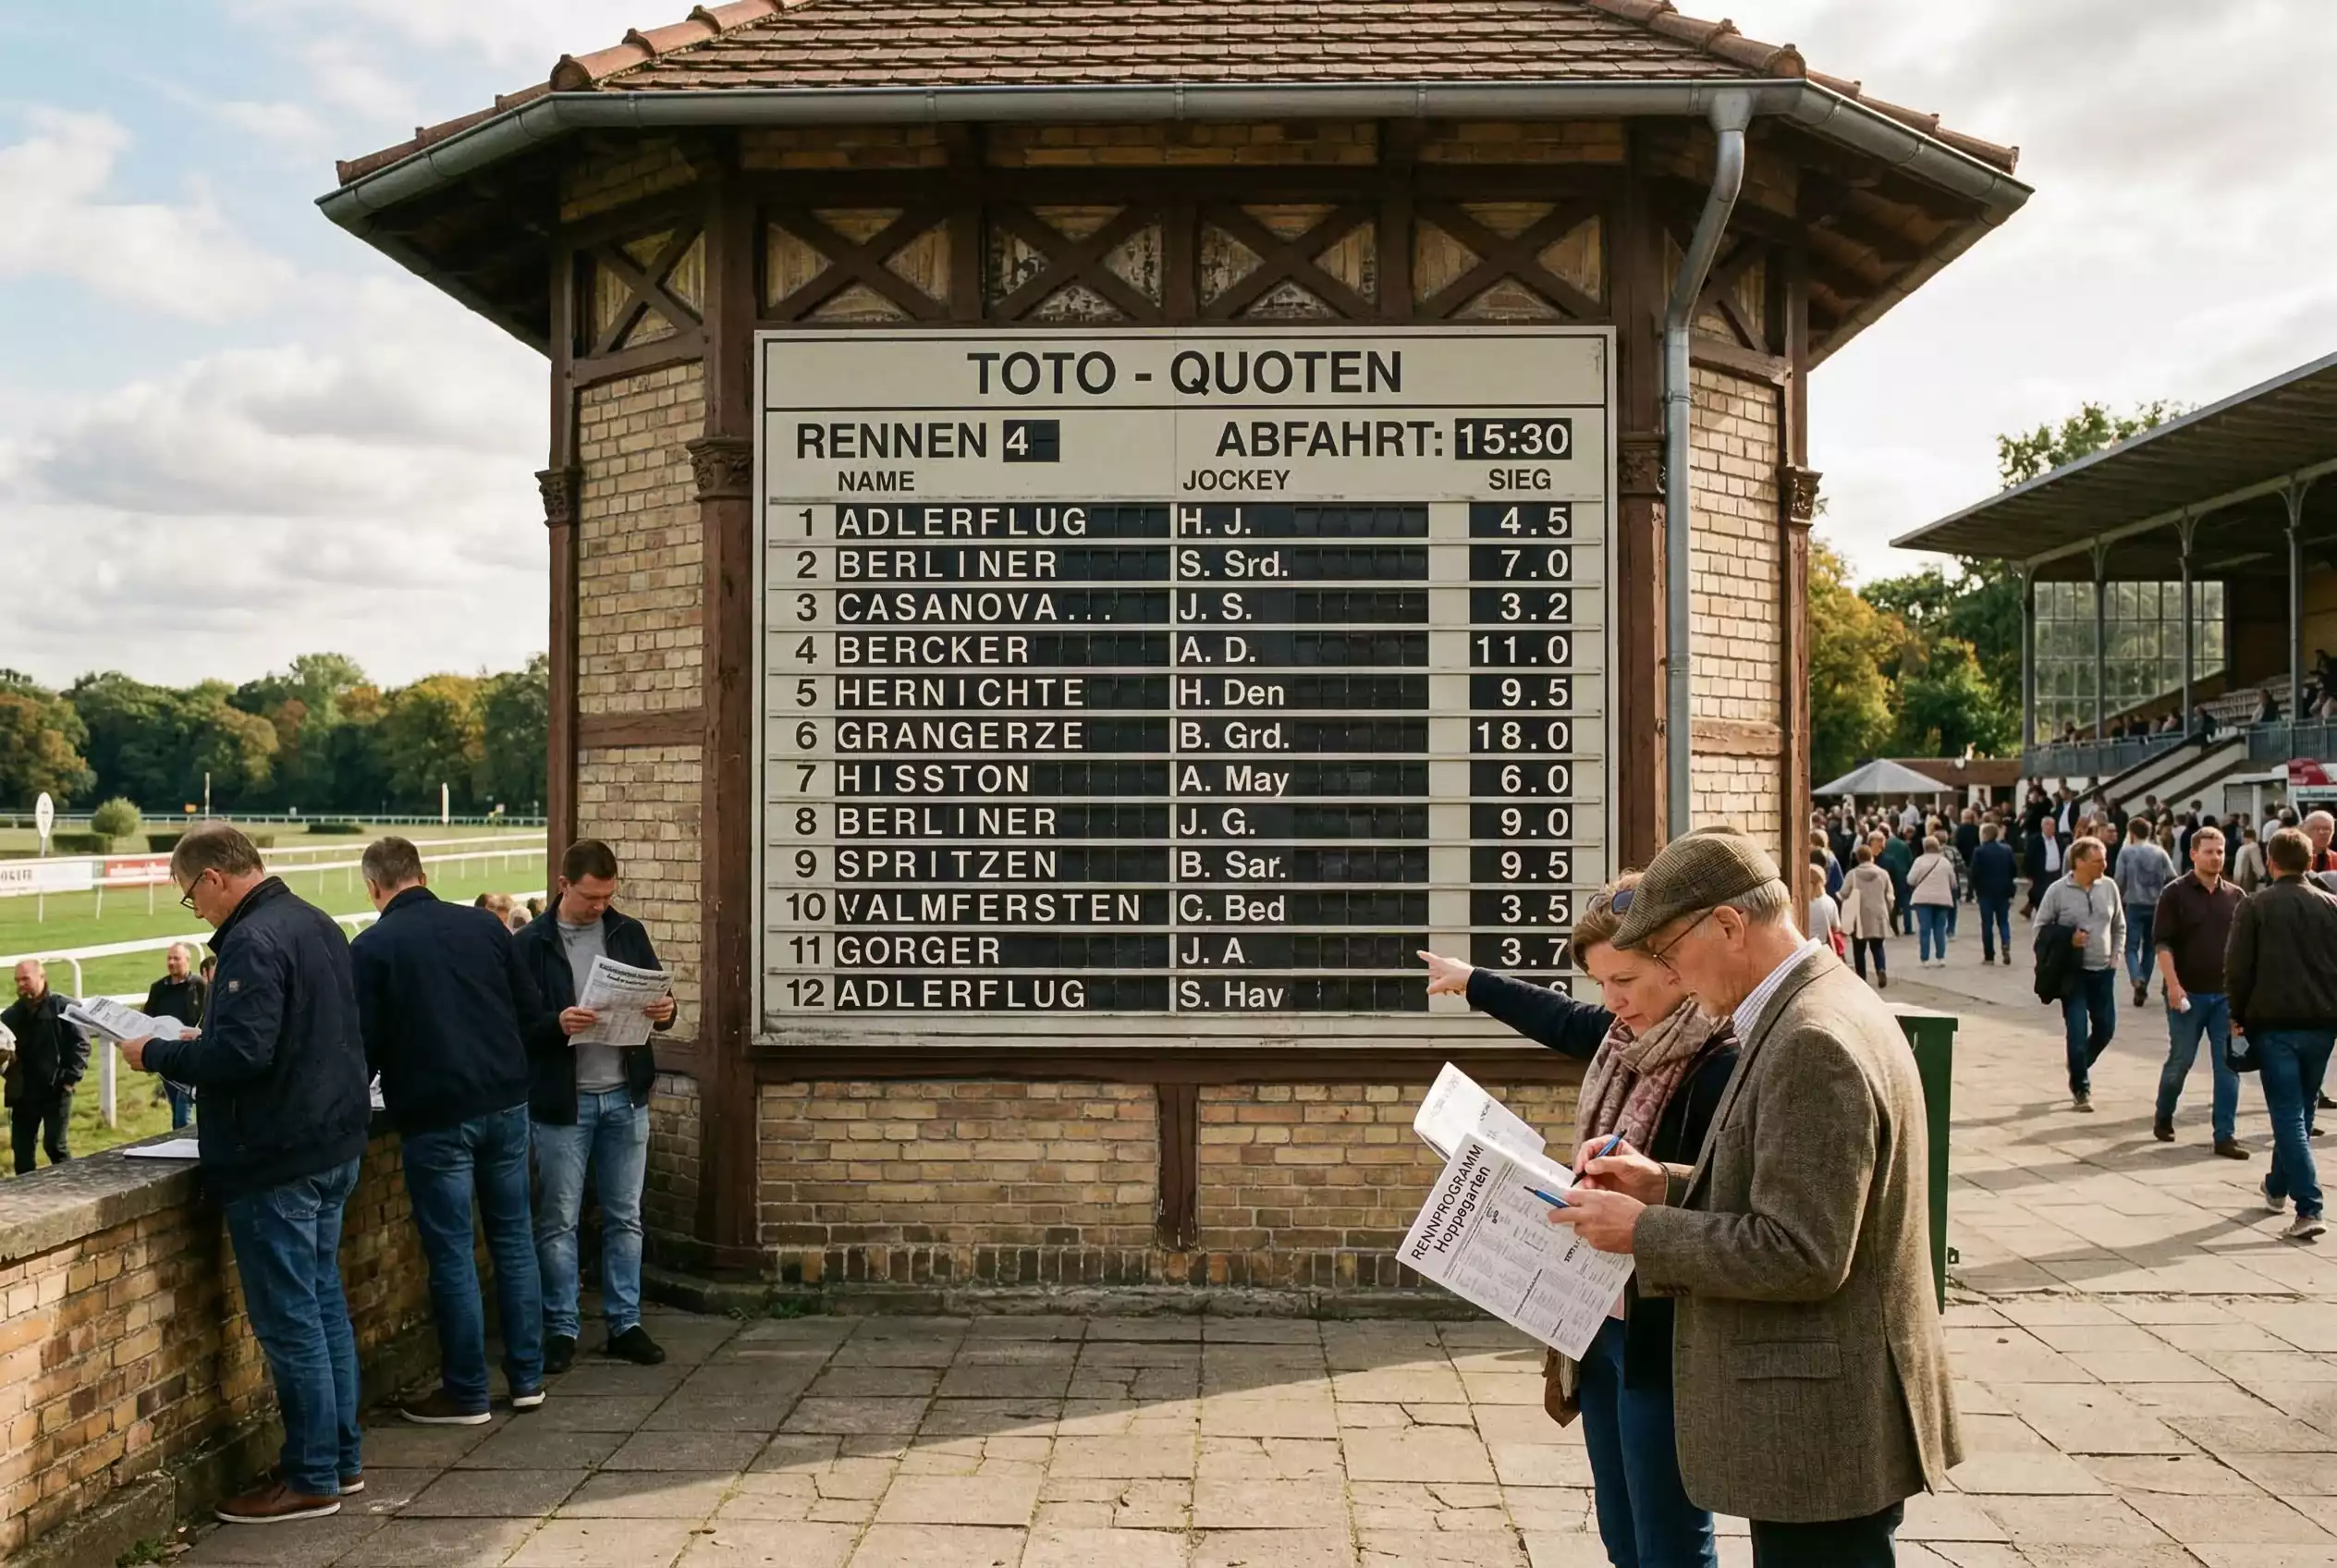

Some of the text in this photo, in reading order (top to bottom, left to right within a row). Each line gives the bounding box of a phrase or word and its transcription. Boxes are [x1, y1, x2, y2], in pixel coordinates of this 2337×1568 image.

[966, 350, 1116, 396] TOTO
[1170, 350, 1401, 397] QUOTEN
[797, 422, 1029, 459] RENNEN 4
[1215, 421, 1569, 458] ABFAHRT: 15:30
[838, 471, 915, 492] NAME
[1182, 469, 1291, 491] JOCKEY
[1488, 468, 1551, 491] SIEG
[799, 507, 1568, 537] 1 ADLERFLUG H. J. 4.5
[797, 549, 1569, 579] 2 BERLINER S. Srd. 7.0
[796, 593, 817, 622] 3
[1180, 593, 1207, 620] J.
[1221, 592, 1252, 620] S.
[1500, 592, 1568, 620] 3.2
[795, 635, 1569, 665] 4 BERCKER A. D. 11.0
[796, 678, 1568, 707] 5 HERNICHTE H. Den 9.5
[796, 721, 1569, 750] 6 GRANGERZE B. Grd. 18.0
[796, 764, 1569, 798] 7 HISSTON A. May 6.0
[795, 807, 1569, 837] 8 BERLINER J. G. 9.0
[795, 849, 1569, 879] 9 SPRITZEN B. Sar. 9.5
[786, 892, 1569, 924] 10 VALMFERSTEN C. Bed 3.5
[789, 936, 1569, 966] 11 GORGER J. A 3.7
[786, 978, 1284, 1008] 12 ADLERFLUG S. Hav
[1411, 1144, 1484, 1260] RENNPROGRAMM
